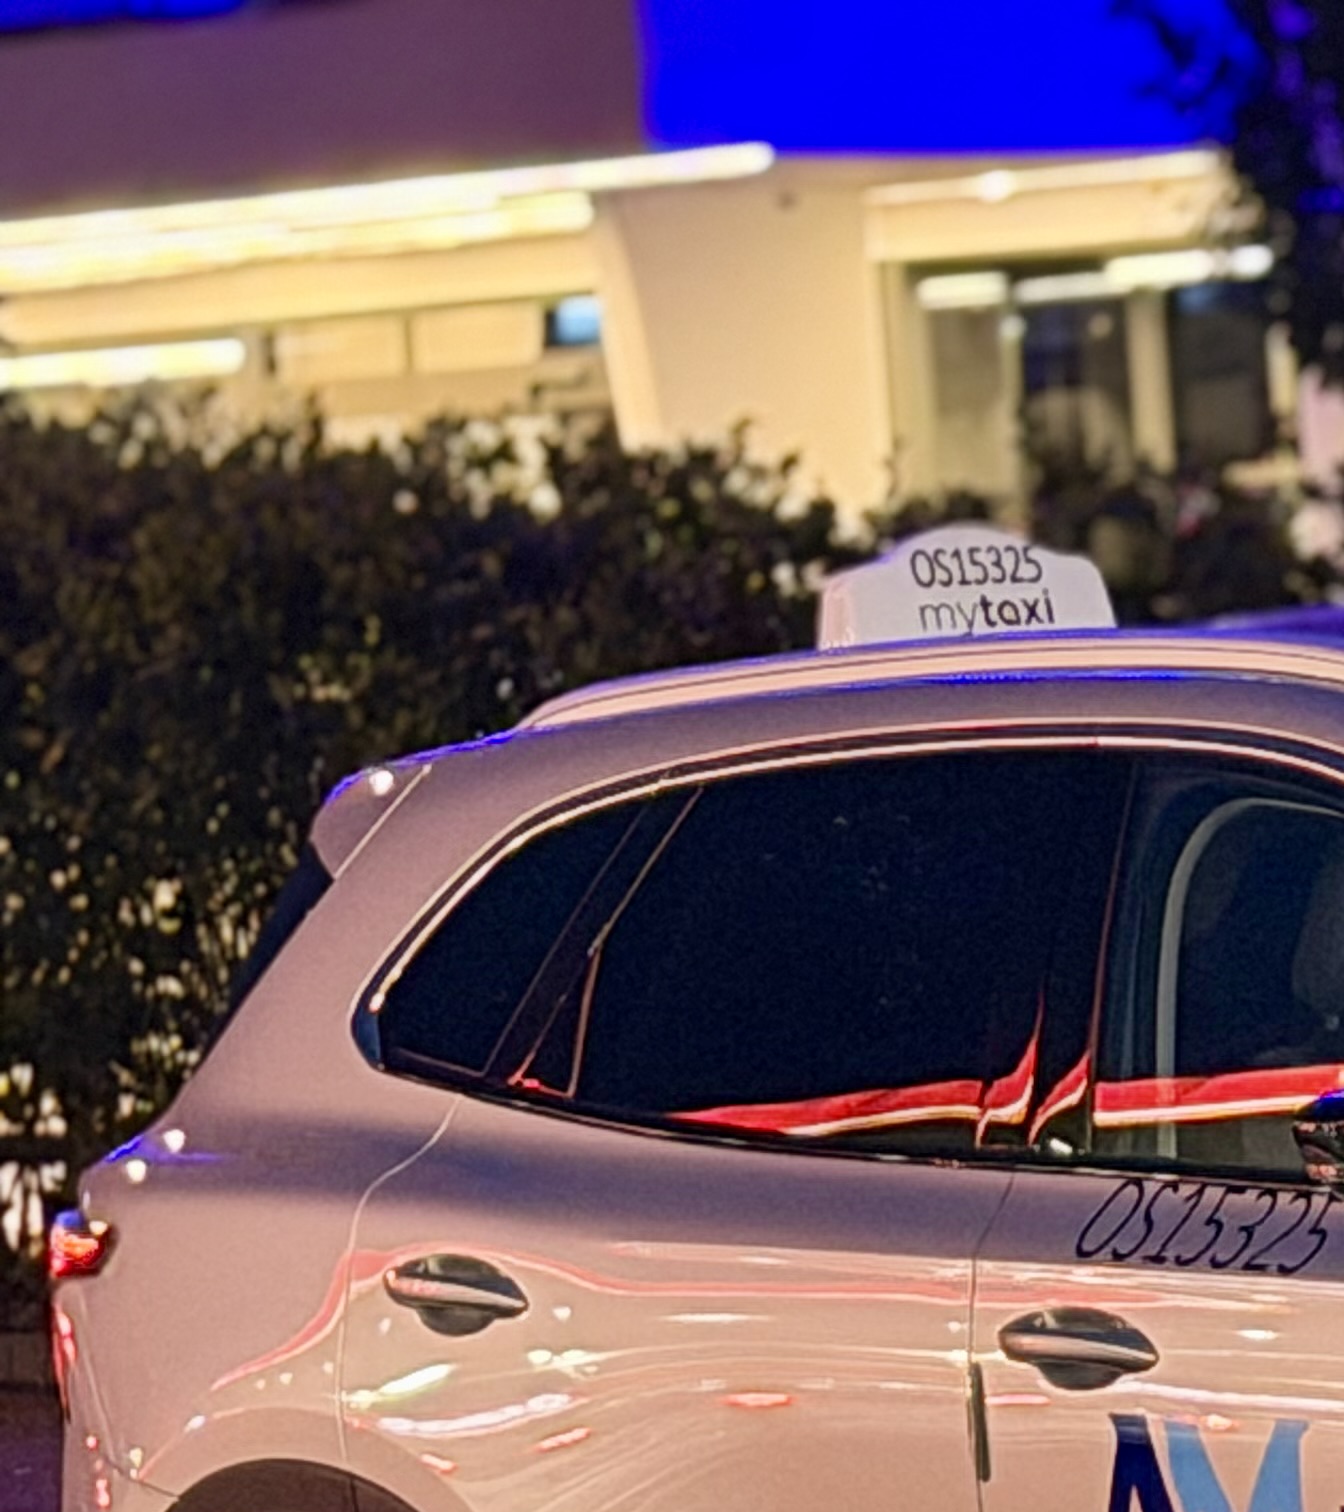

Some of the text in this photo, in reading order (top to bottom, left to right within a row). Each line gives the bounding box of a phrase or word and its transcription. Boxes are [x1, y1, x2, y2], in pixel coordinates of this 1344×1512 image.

[909, 544, 1043, 588] OS15325
[918, 588, 1055, 637] mytaxi
[1075, 1177, 1343, 1274] OS15325
